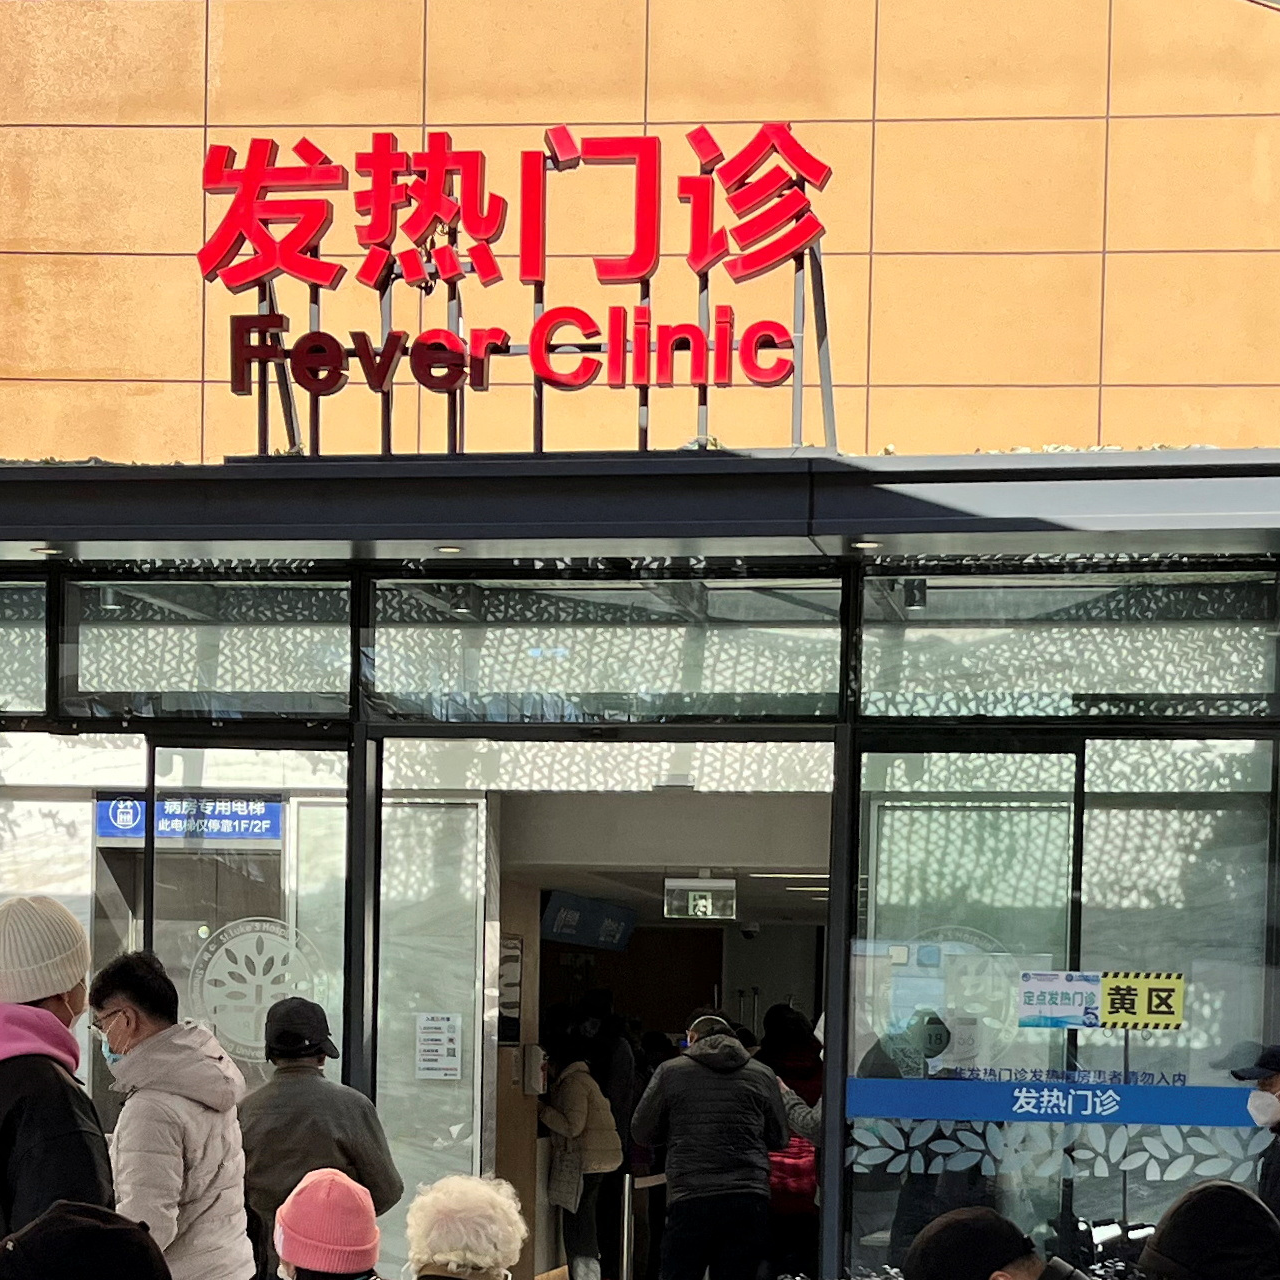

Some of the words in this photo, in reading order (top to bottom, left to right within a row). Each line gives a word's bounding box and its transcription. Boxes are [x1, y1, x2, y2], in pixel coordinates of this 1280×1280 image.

[196, 122, 832, 294] 发热门诊
[229, 313, 509, 396] Fever
[529, 304, 794, 390] Clinic
[164, 798, 266, 816] 病房专用电梯
[158, 818, 272, 832] 此电梯仅停靠1F/2F
[1023, 990, 1096, 1007] 定点发热门诊
[1107, 985, 1176, 1016] 黄区
[1012, 1087, 1121, 1116] 发热门诊
